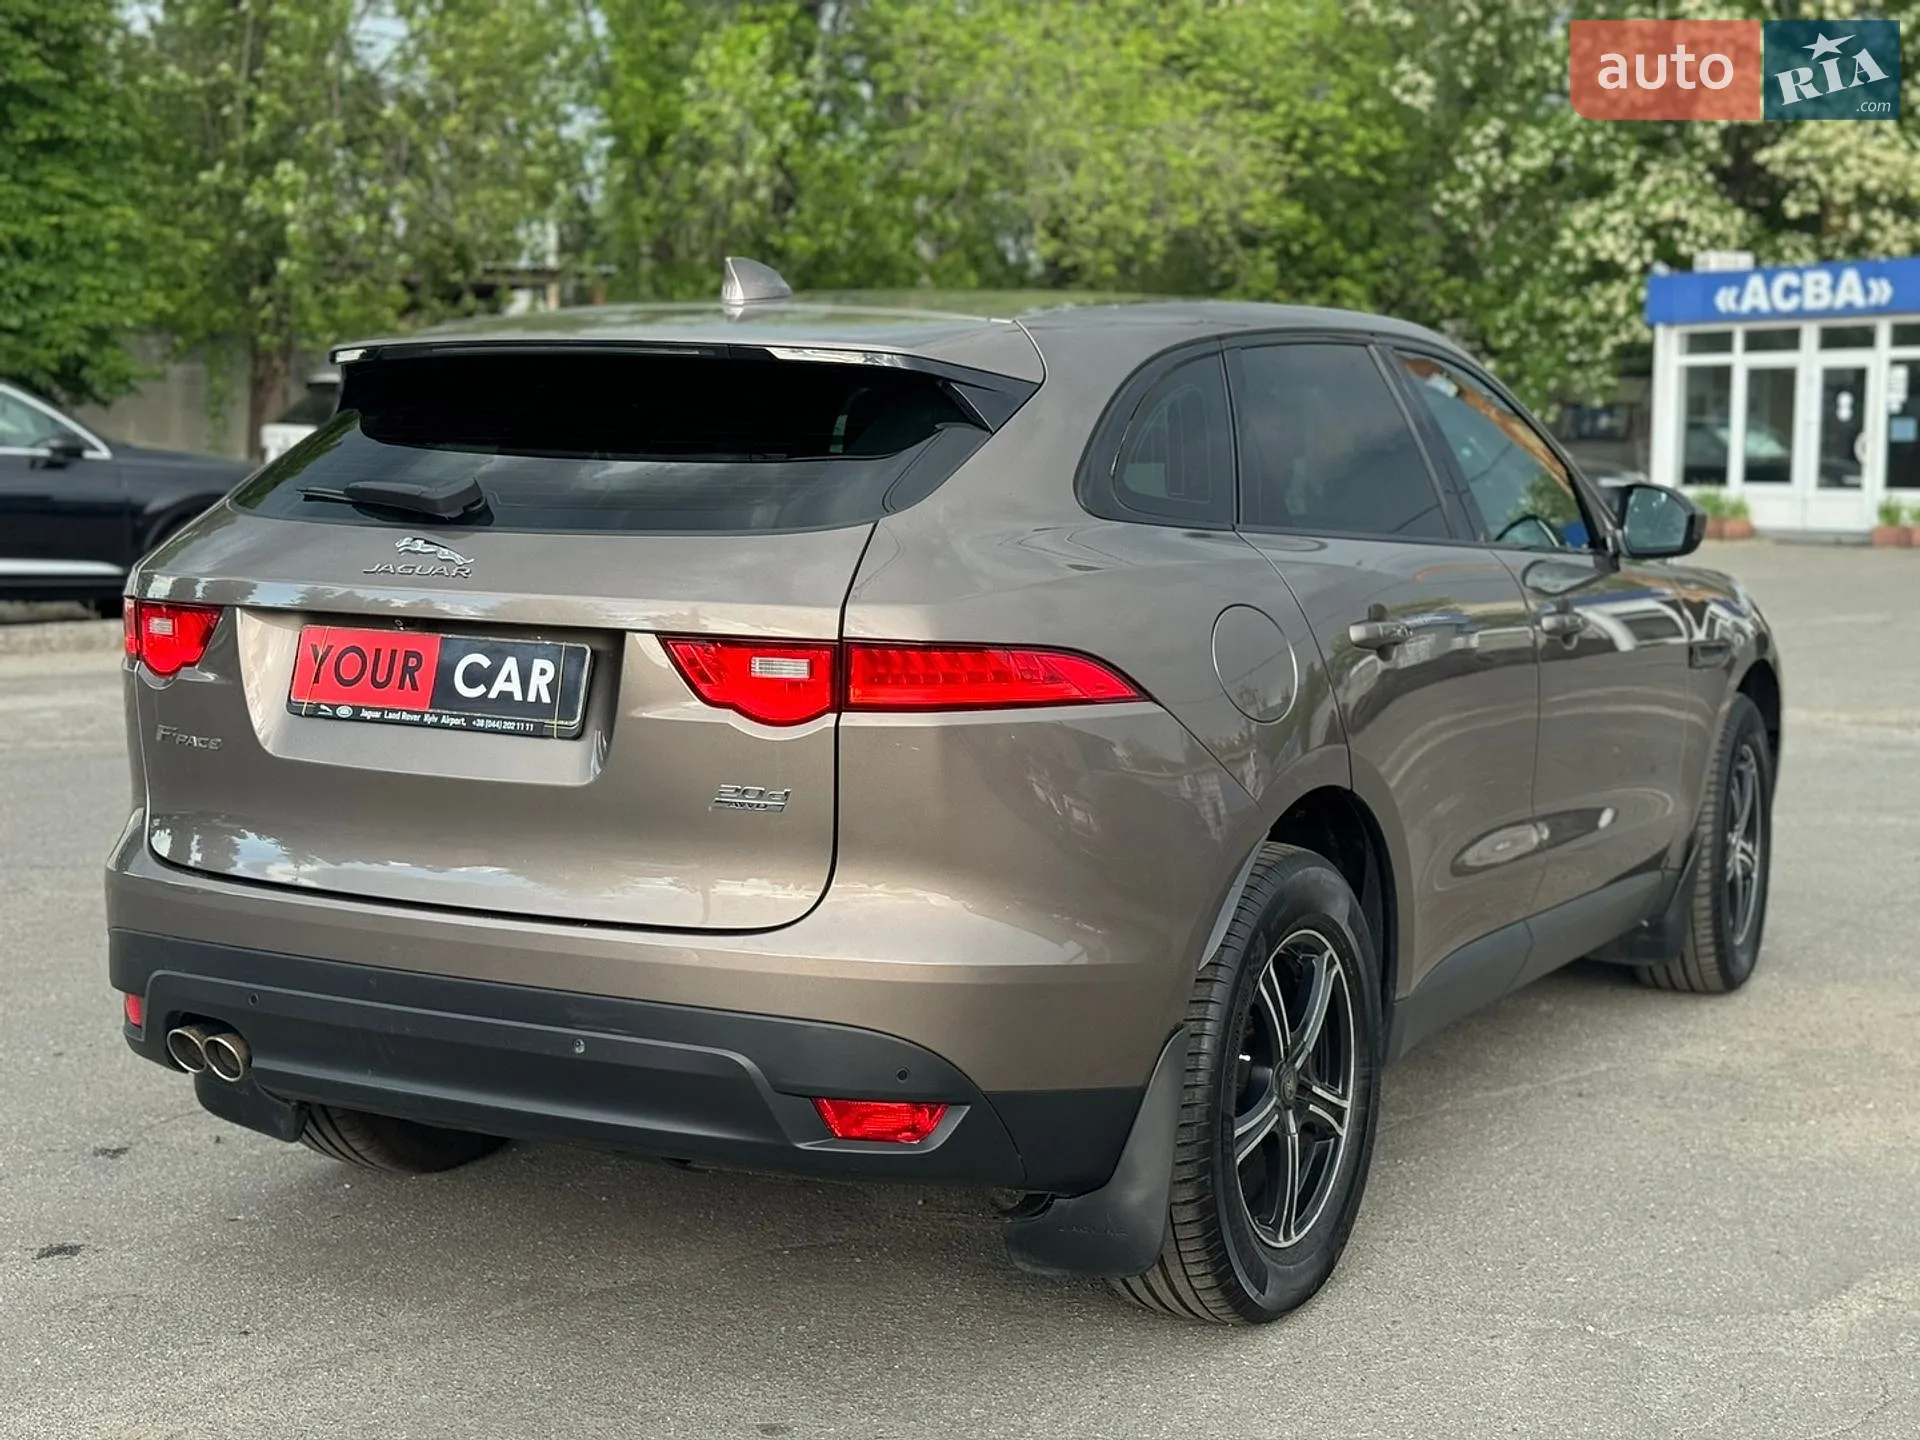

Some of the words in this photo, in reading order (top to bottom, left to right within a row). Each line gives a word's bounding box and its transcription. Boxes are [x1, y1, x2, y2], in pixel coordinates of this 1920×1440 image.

[362, 563, 473, 579] JAGUAR
[309, 643, 424, 693] YOUR
[453, 653, 556, 704] CAR
[360, 708, 382, 720] Jaguar
[384, 710, 401, 720] Land
[402, 711, 421, 721] Rover
[423, 713, 439, 724] Kyiv
[717, 783, 792, 801] 20d
